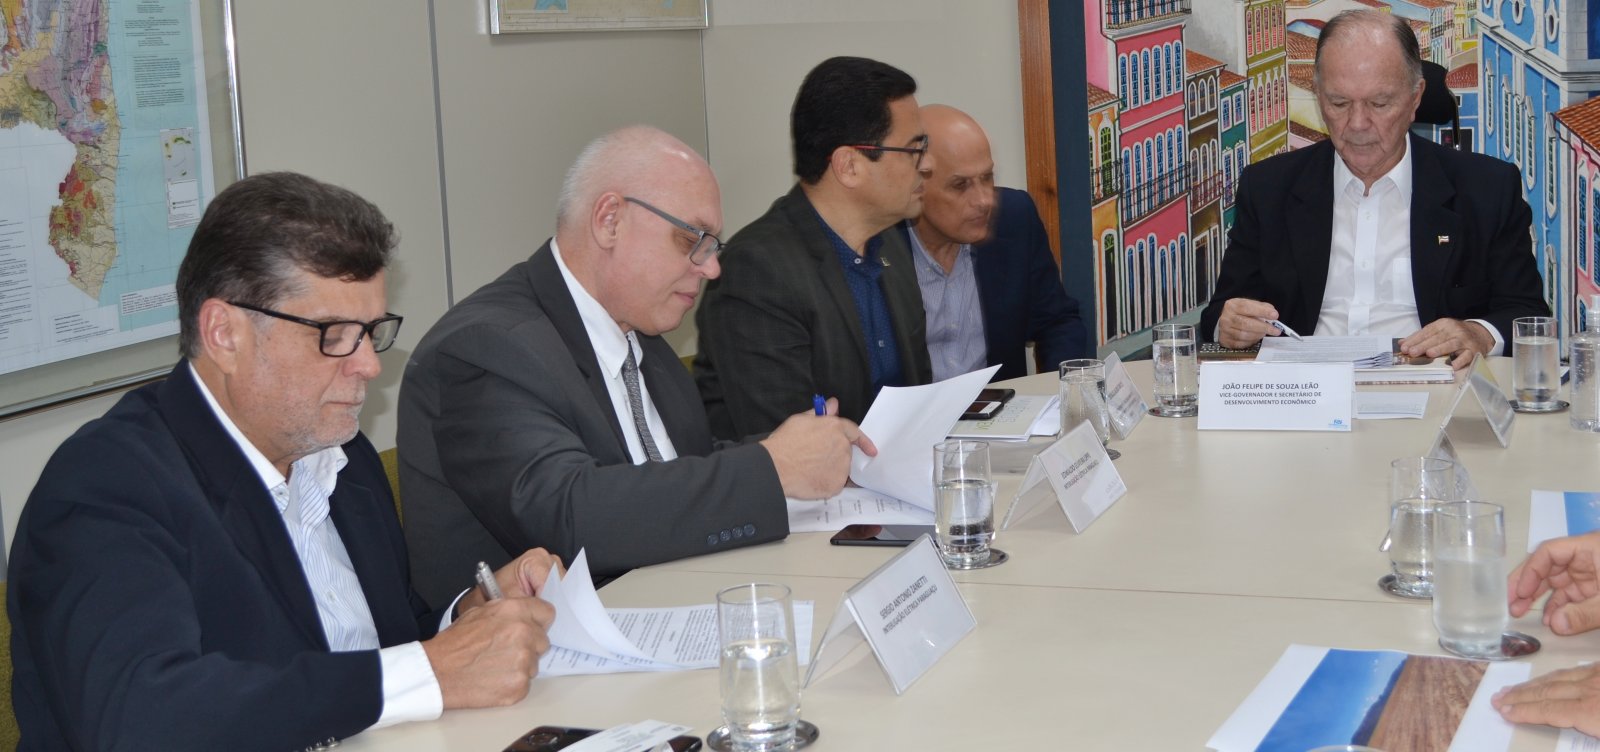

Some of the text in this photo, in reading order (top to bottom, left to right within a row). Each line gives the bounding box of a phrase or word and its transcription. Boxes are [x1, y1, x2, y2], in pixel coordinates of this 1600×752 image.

[1222, 382, 1241, 390] JOÃO
[1301, 382, 1319, 390] LEÃO
[893, 587, 912, 608] ANTONIO
